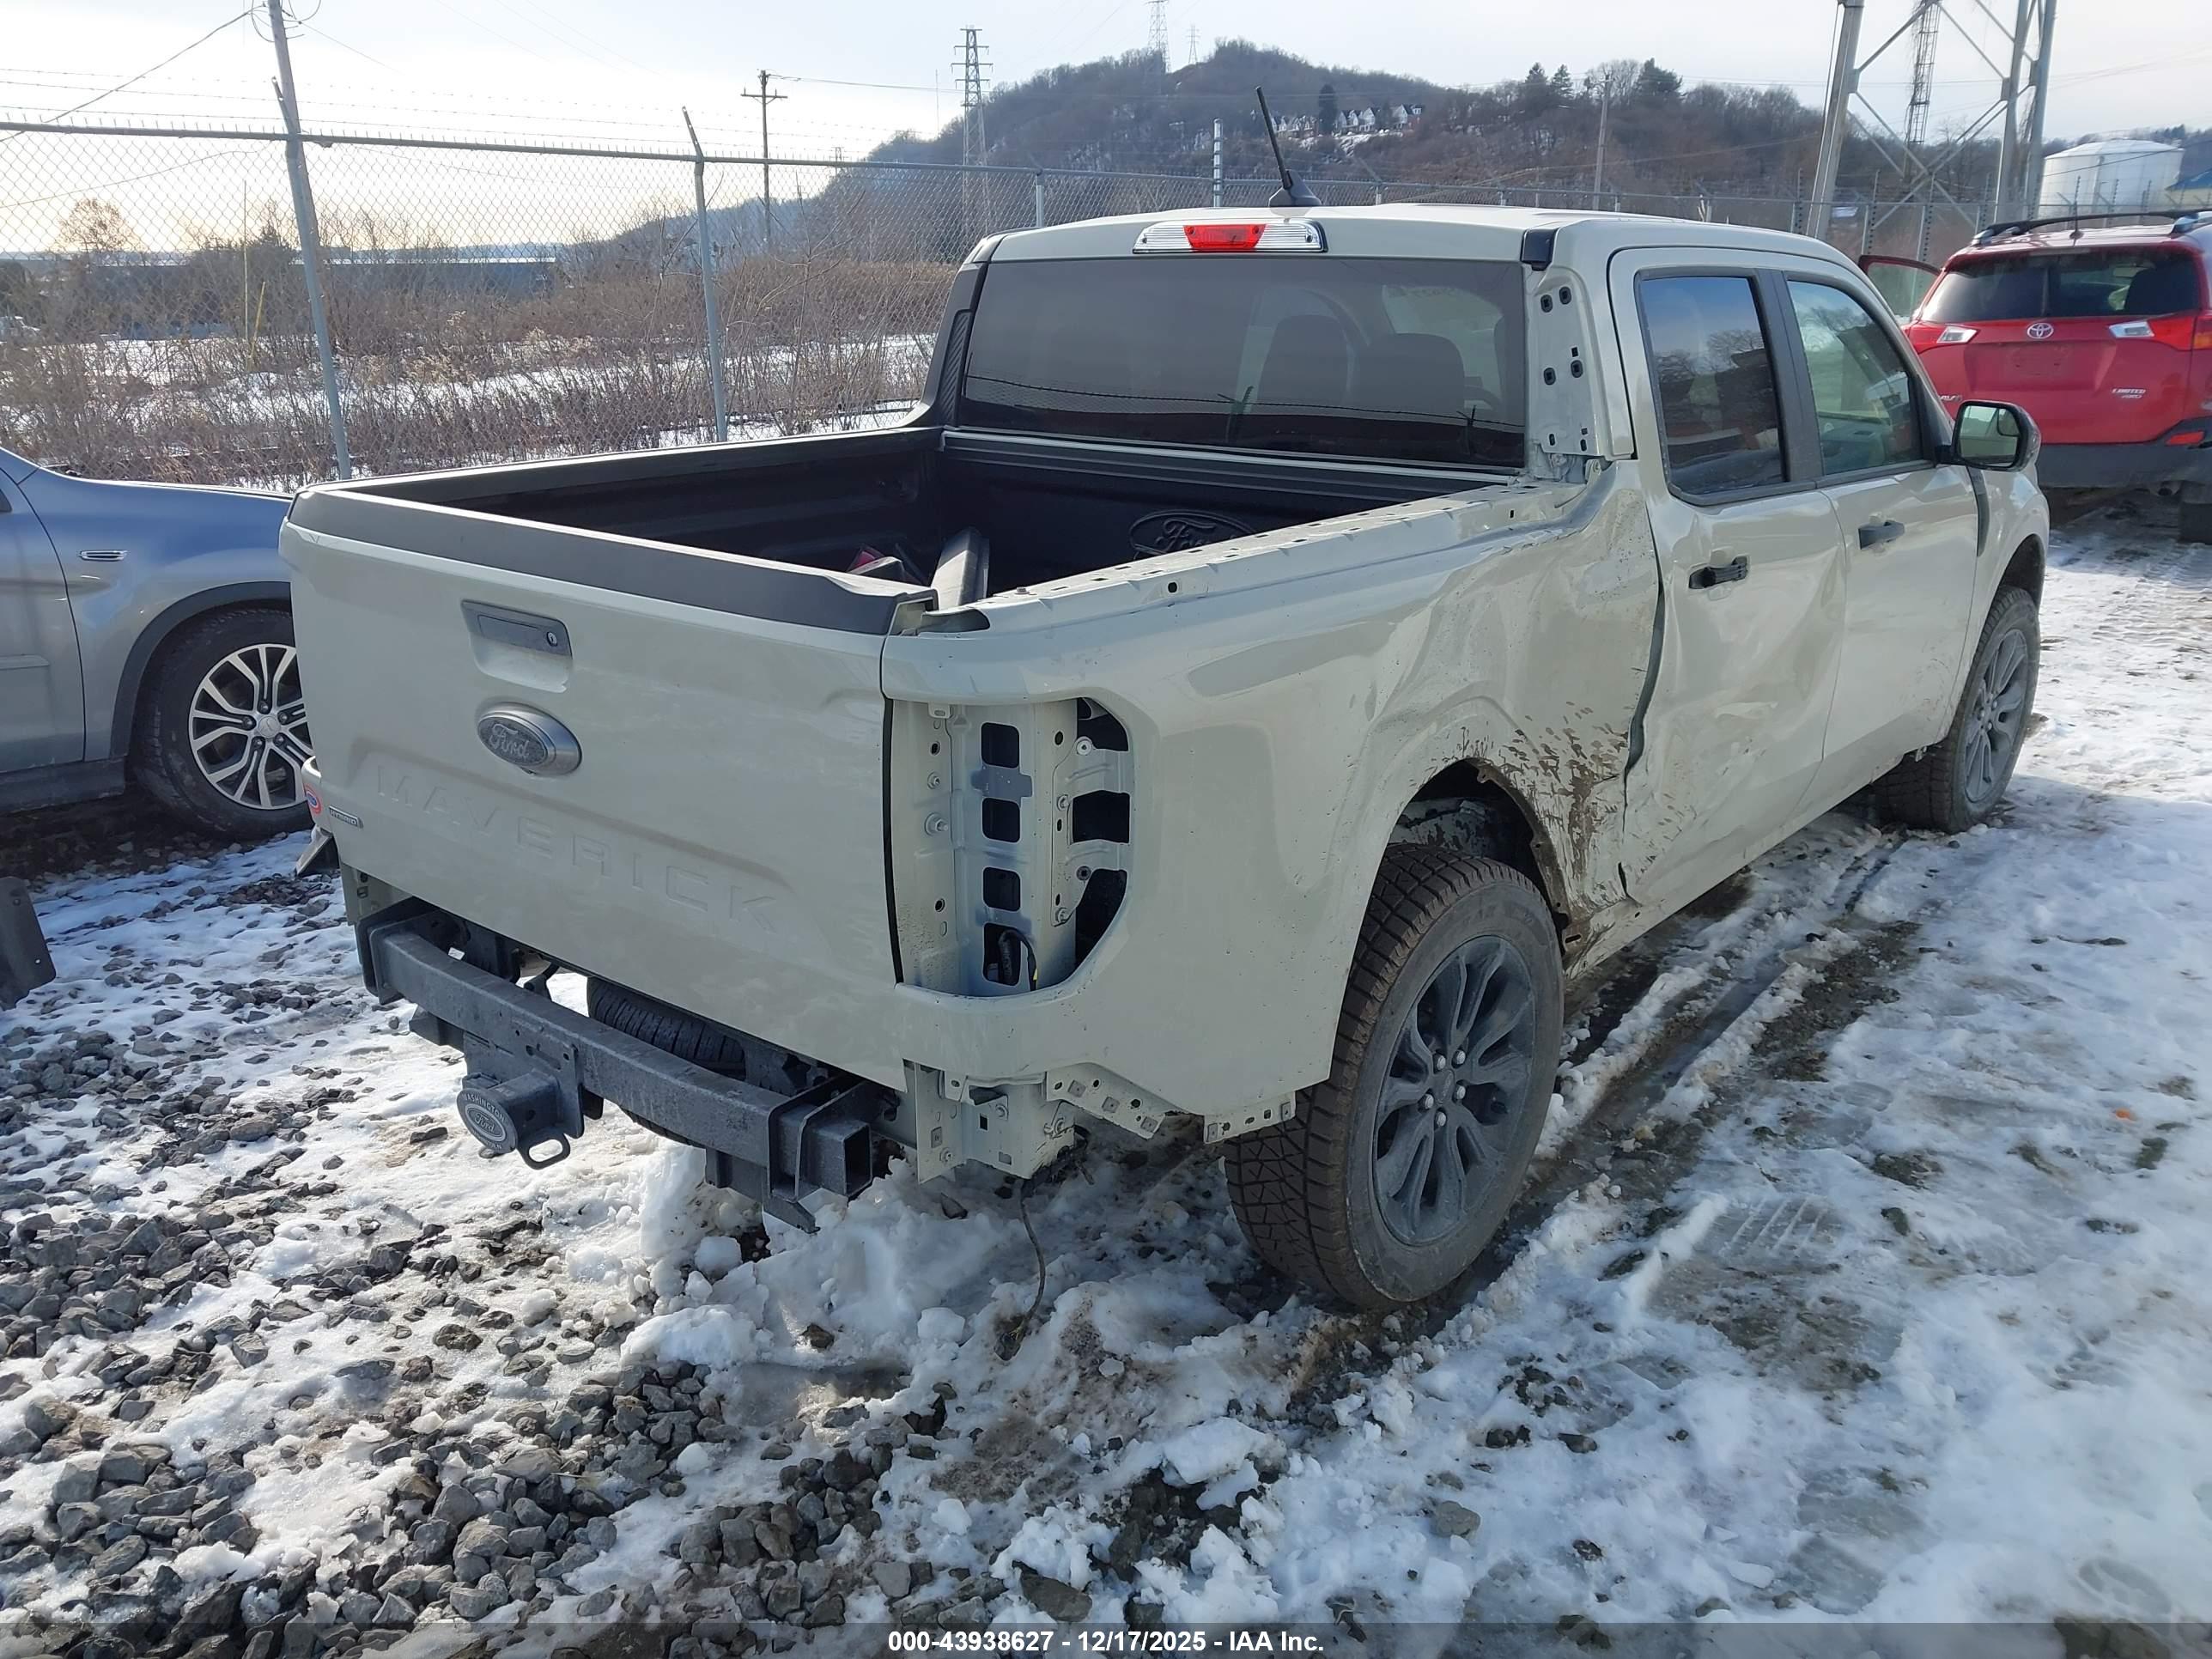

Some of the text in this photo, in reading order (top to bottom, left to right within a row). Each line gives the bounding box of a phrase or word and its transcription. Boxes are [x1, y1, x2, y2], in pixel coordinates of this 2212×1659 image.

[489, 723, 532, 761] Ford
[376, 765, 777, 934] MAVERICK
[461, 1092, 506, 1123] WASHINGTON
[474, 1112, 495, 1133] Ford
